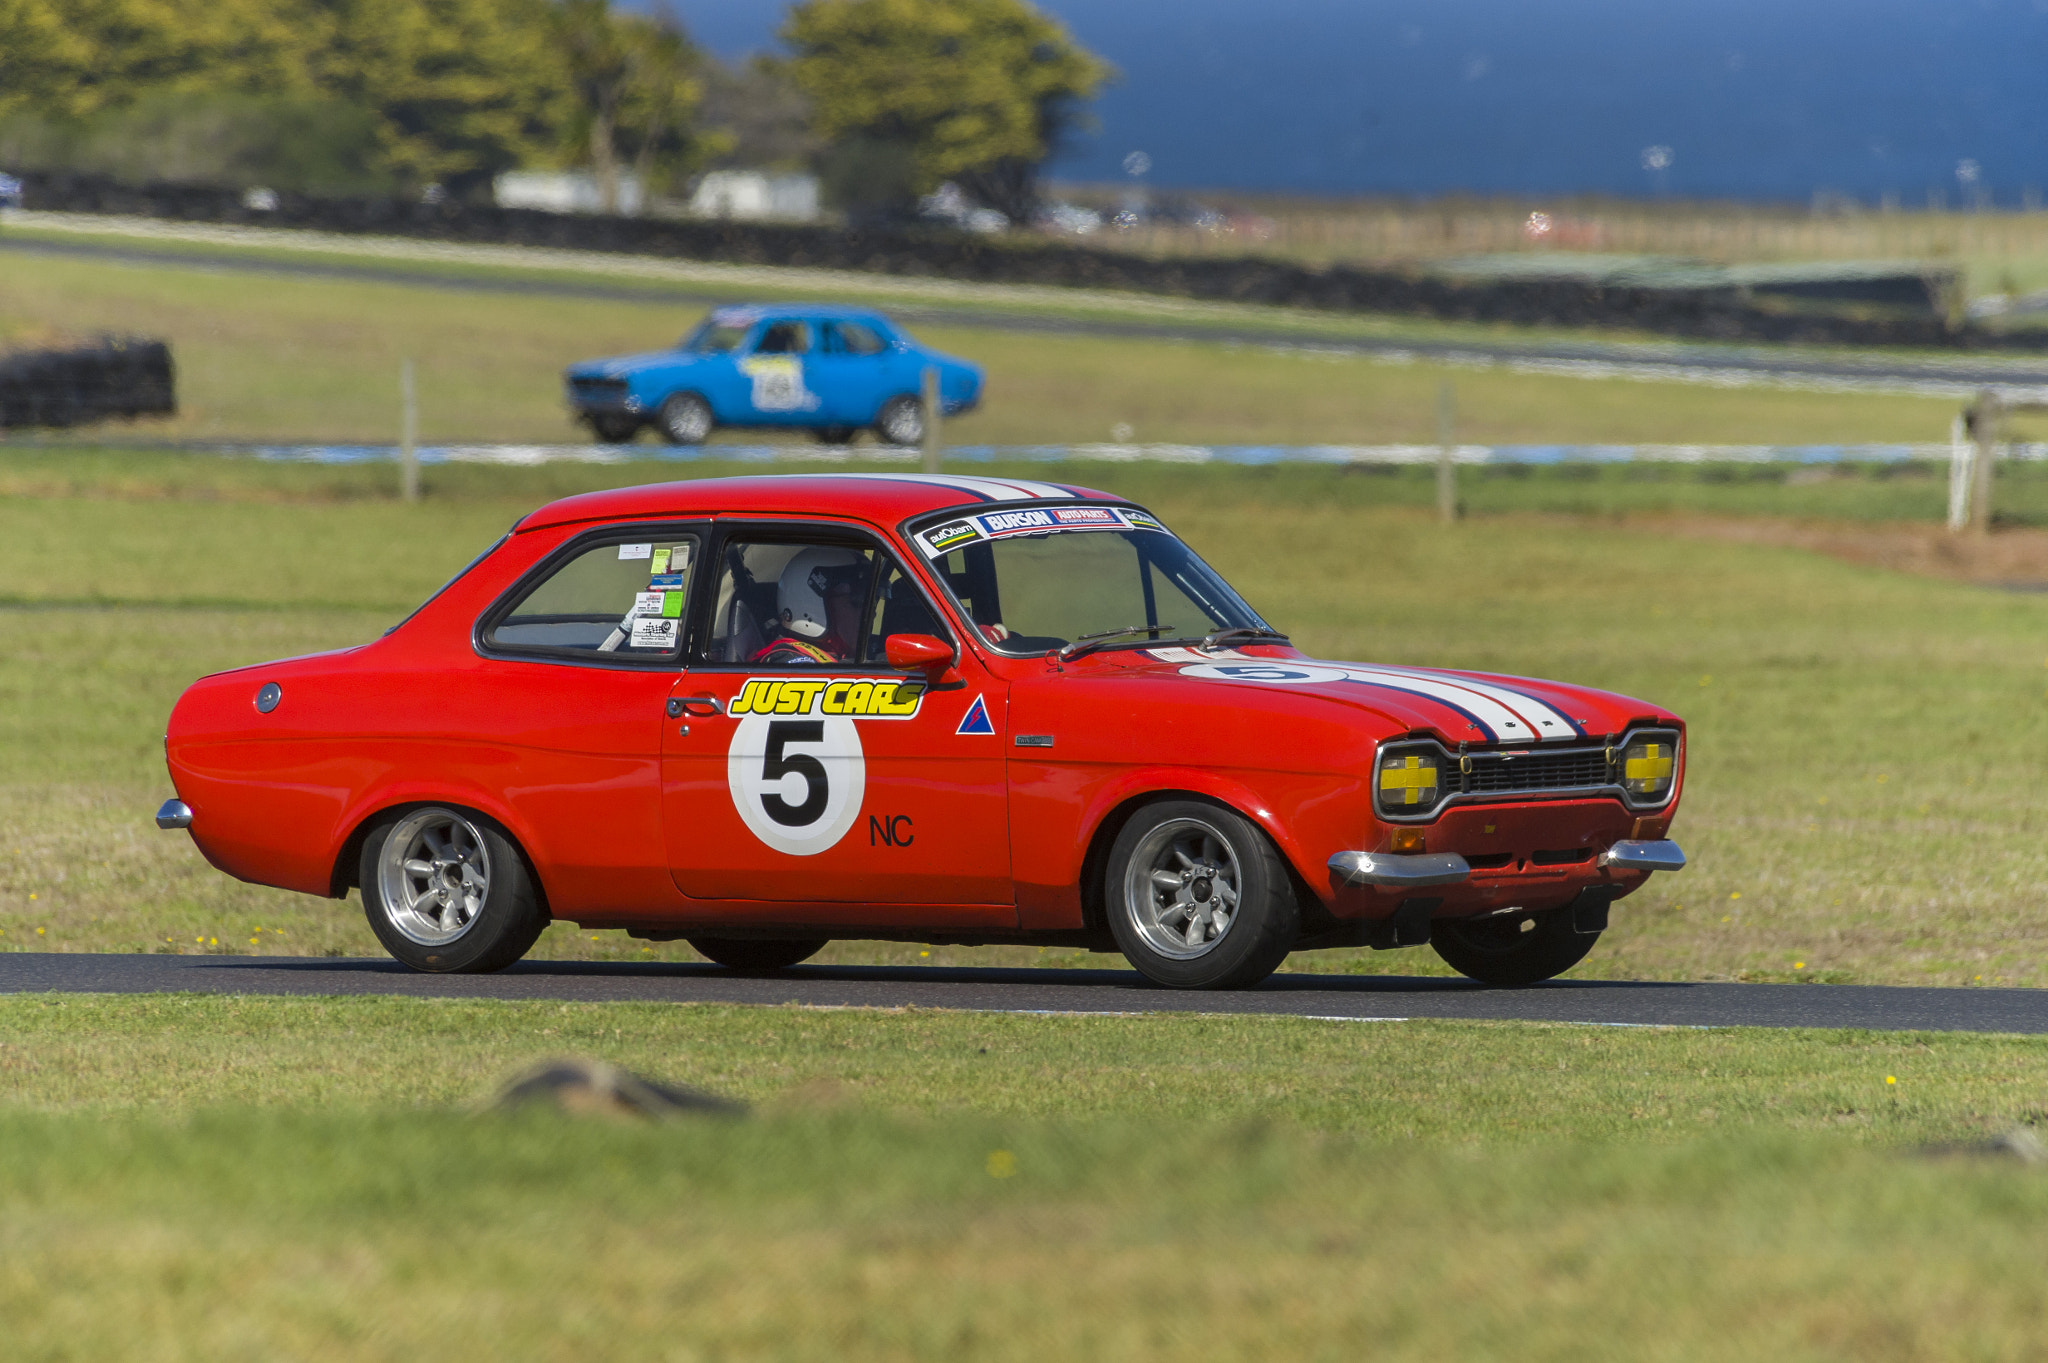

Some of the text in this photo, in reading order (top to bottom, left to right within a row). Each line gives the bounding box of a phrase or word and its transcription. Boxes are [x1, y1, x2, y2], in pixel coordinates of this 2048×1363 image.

[984, 510, 1053, 530] BURSON
[1057, 510, 1109, 520] AUTO PARTS
[1214, 666, 1310, 680] 5
[731, 680, 927, 716] JUST CARS
[759, 719, 829, 827] 5
[869, 814, 915, 847] NC
